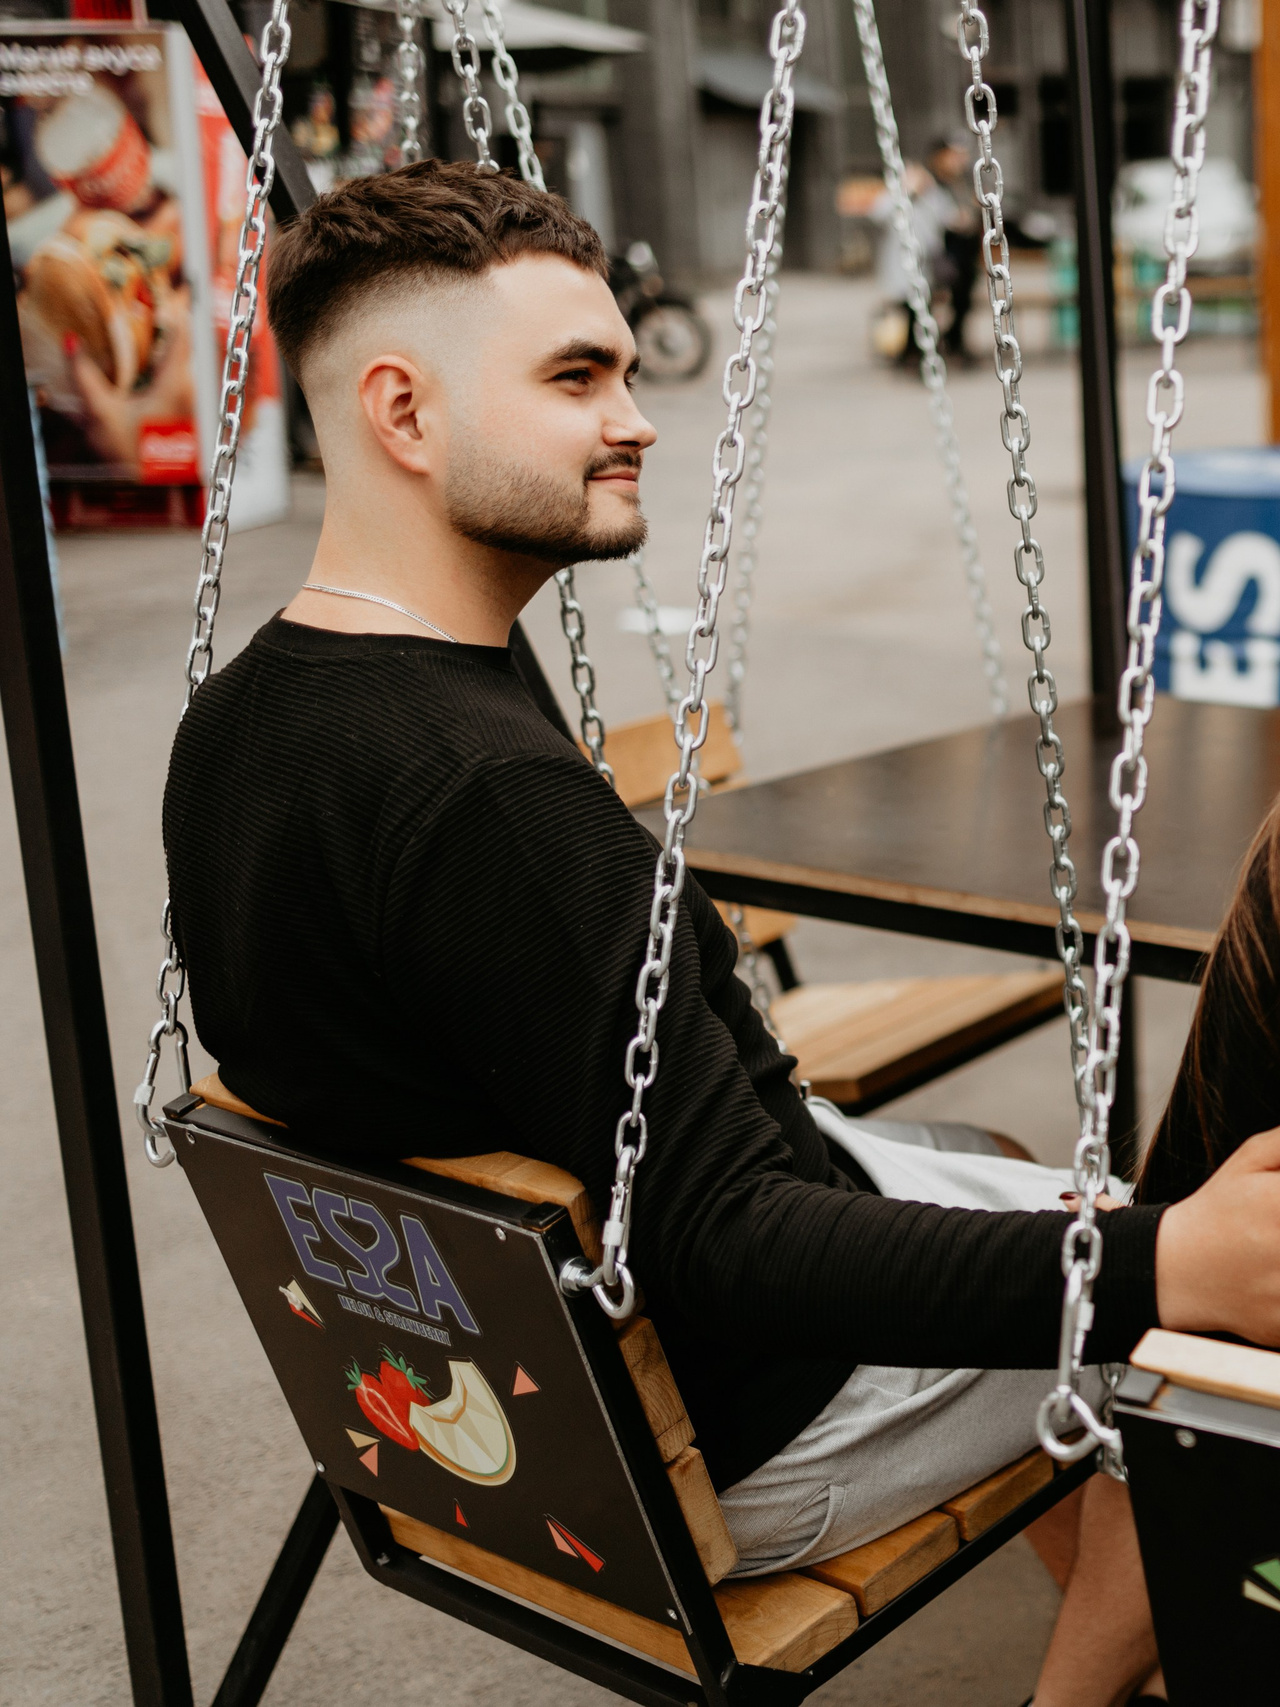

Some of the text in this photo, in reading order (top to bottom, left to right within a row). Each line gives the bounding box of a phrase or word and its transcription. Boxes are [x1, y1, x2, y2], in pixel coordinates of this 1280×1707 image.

[263, 1172, 481, 1335] ESSA
[337, 1294, 452, 1346] MELON & STRAWBERRY
